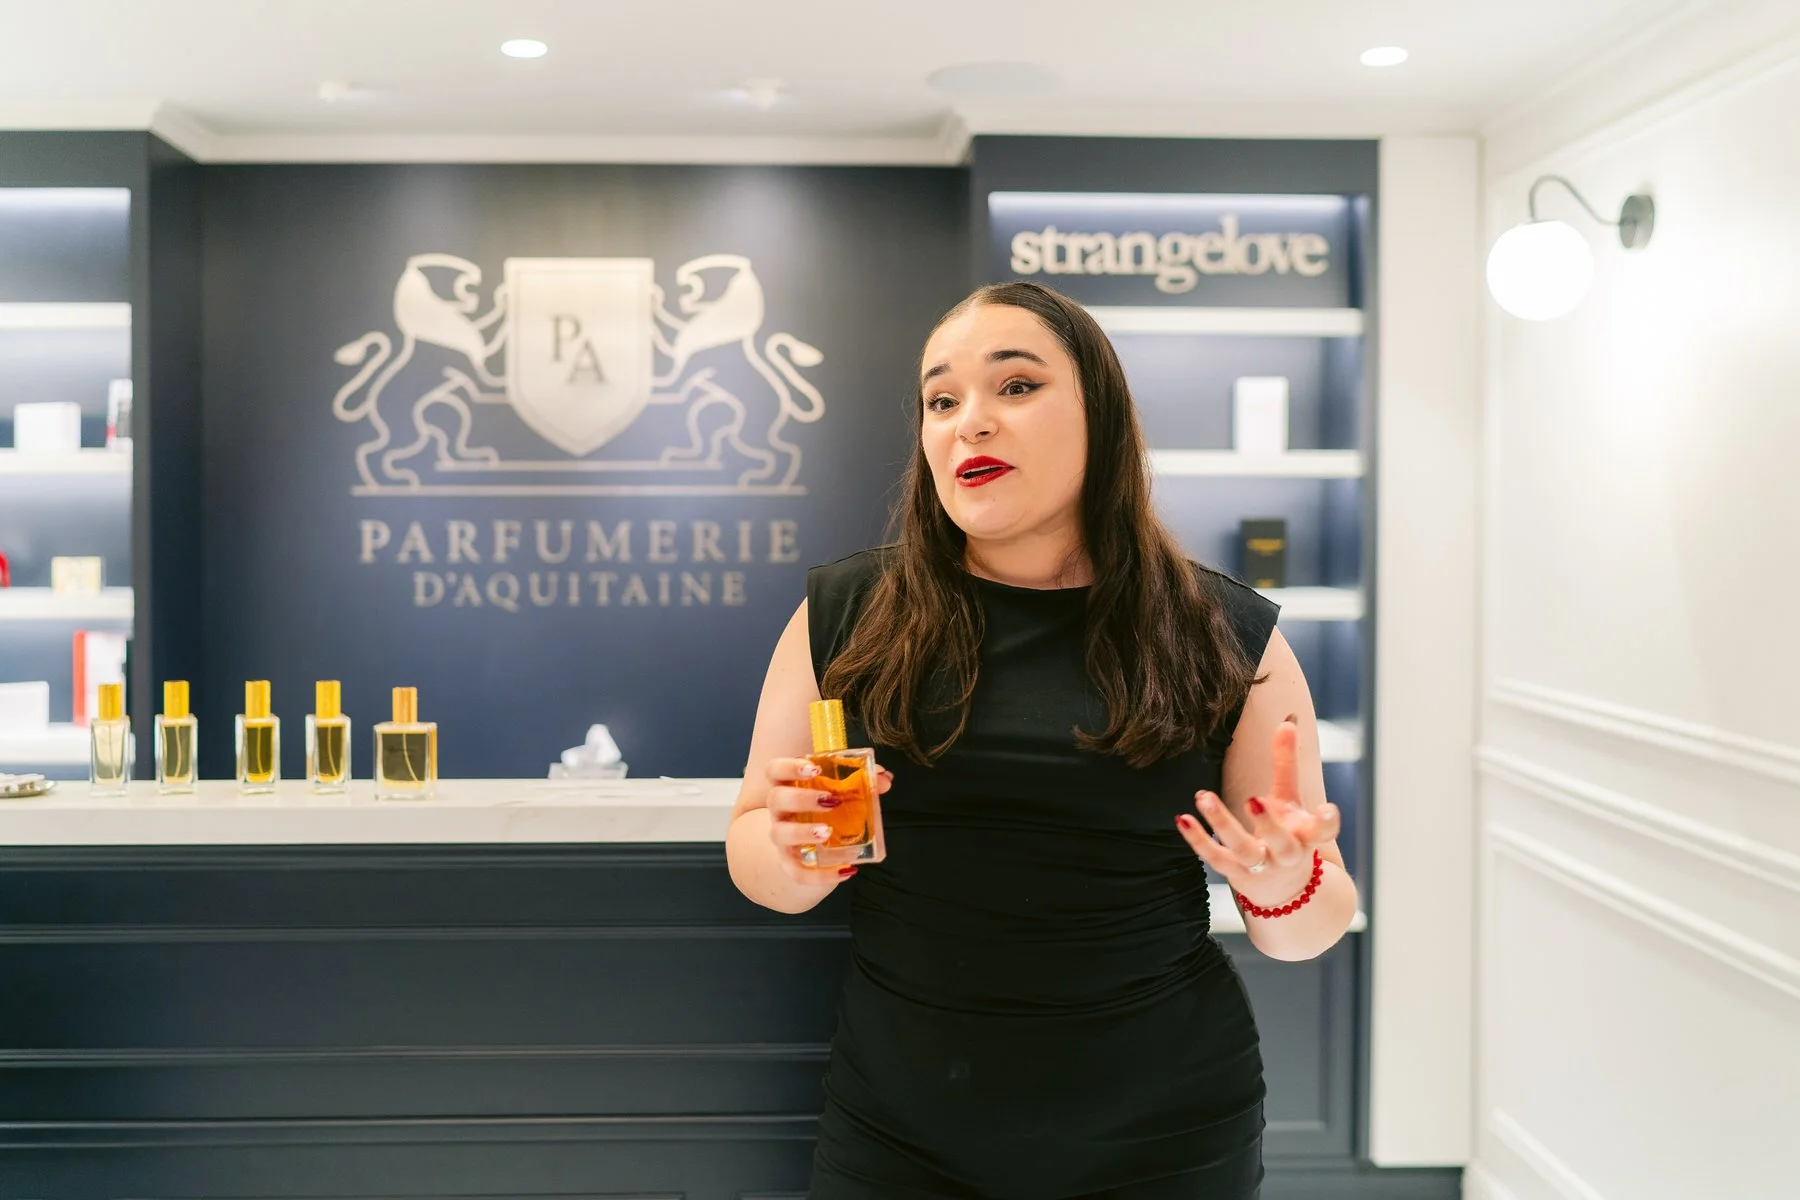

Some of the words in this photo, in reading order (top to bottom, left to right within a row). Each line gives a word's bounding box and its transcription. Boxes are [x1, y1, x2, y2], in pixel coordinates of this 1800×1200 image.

[1011, 213, 1329, 294] strangelove
[359, 520, 800, 564] PARFUMERIE
[413, 572, 747, 612] D'AQUITAINE
